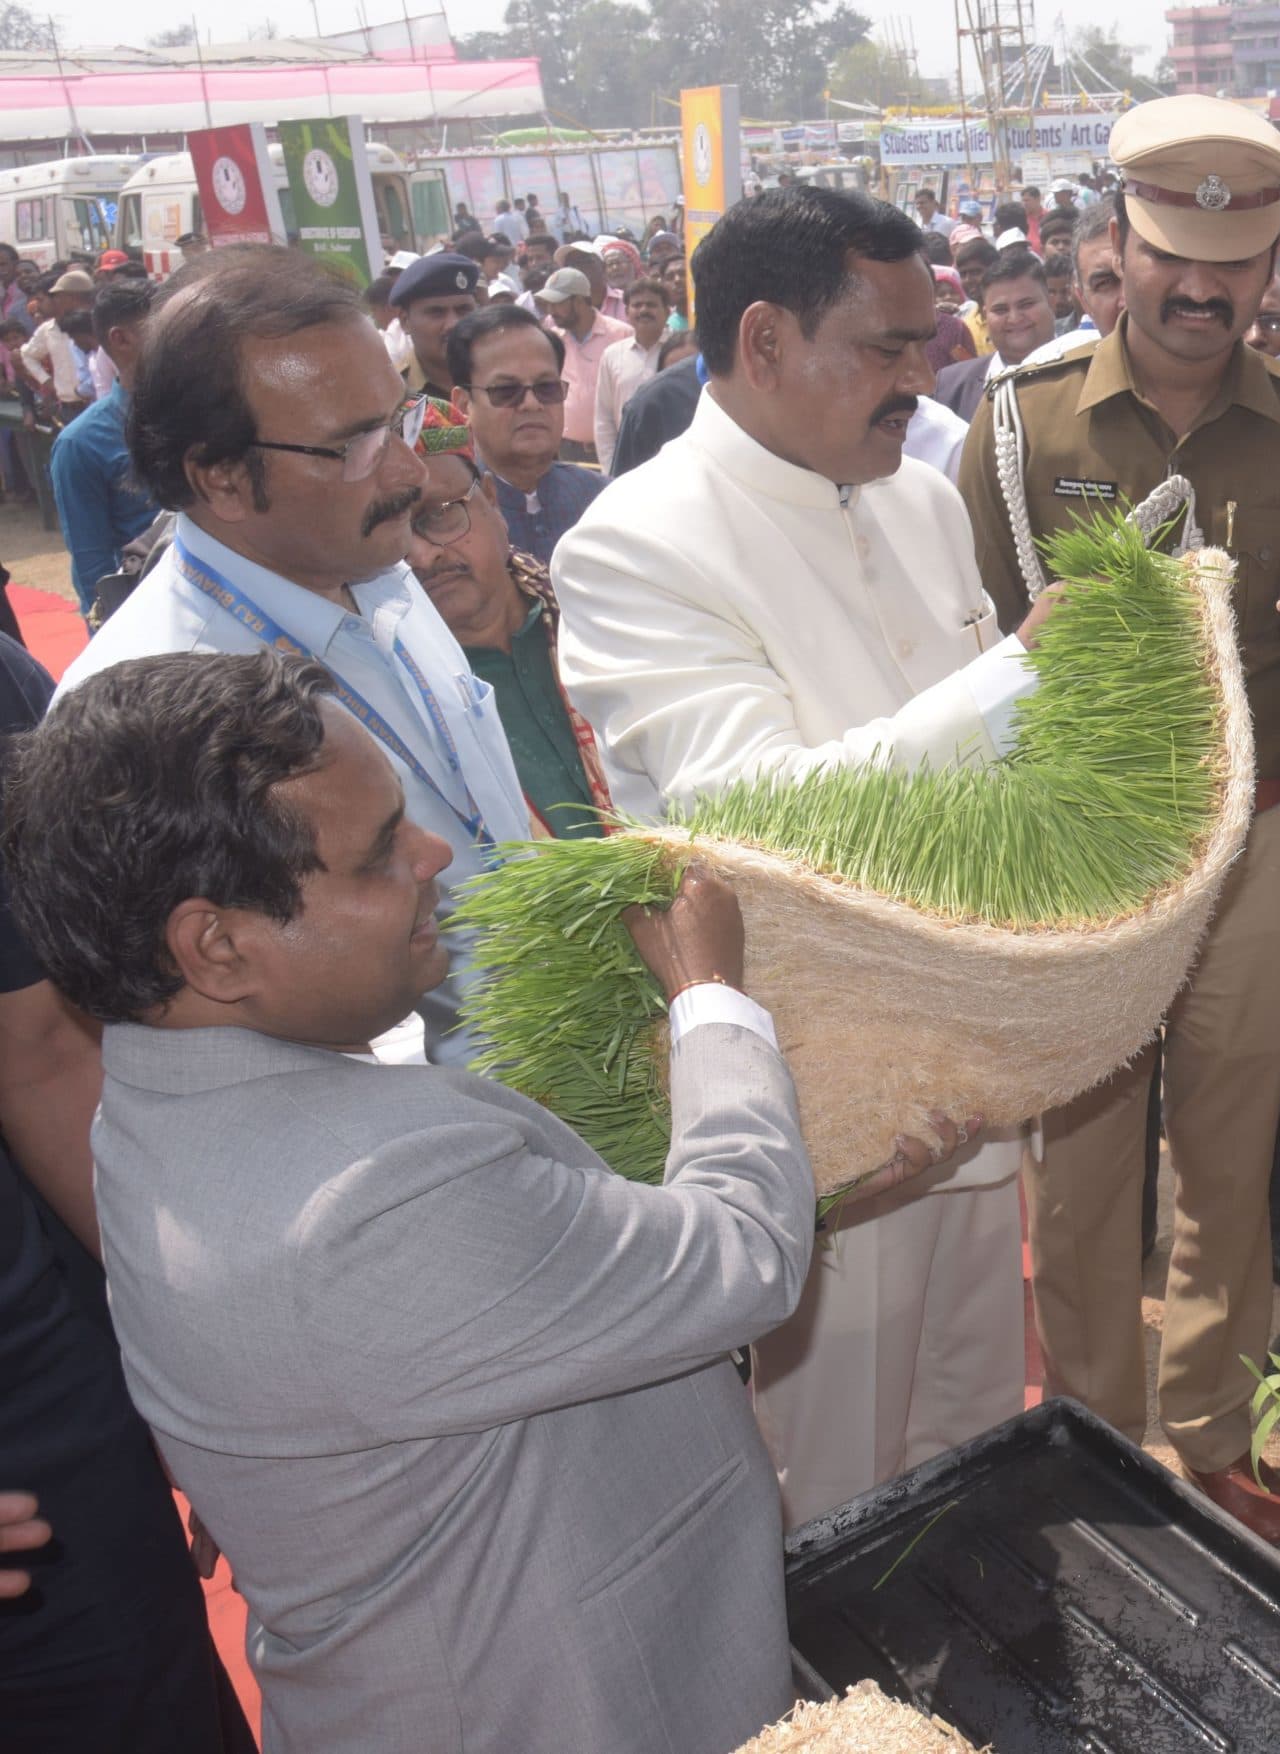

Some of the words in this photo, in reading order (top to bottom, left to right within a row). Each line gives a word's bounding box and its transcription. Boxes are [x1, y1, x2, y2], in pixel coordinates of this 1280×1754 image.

[884, 130, 932, 154] Students'
[936, 131, 955, 153] Art
[1071, 124, 1090, 146] Art
[234, 603, 265, 633] RAJ
